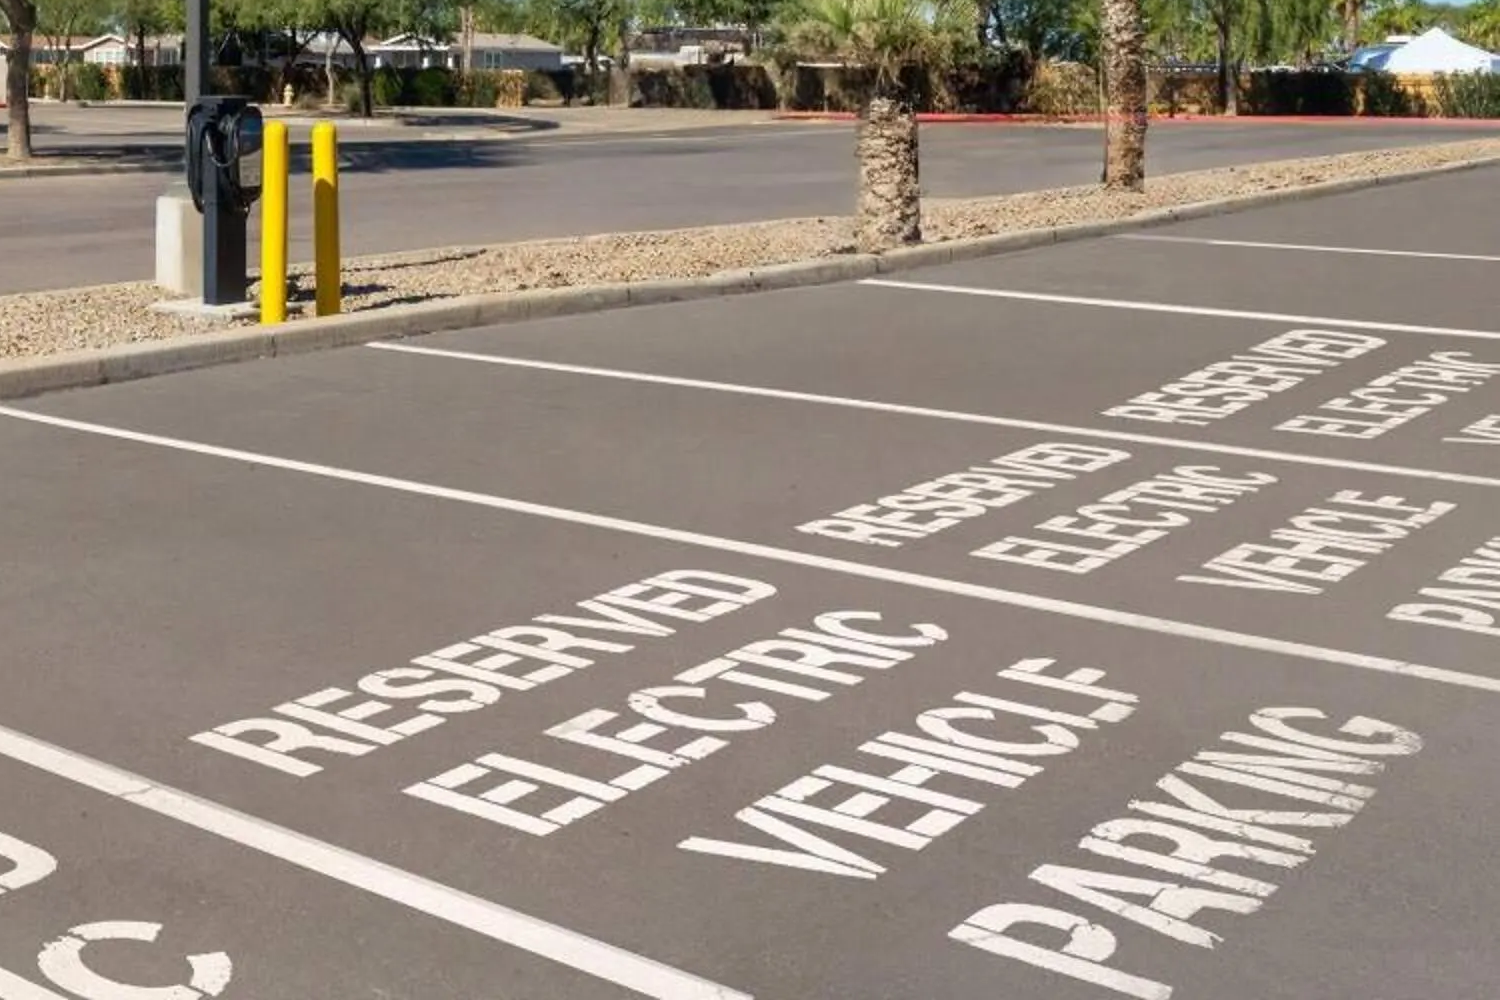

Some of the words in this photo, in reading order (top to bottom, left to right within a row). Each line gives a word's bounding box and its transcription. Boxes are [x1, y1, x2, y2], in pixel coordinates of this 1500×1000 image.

[1102, 329, 1388, 427] RESERVED
[795, 443, 1133, 548] RESERVED
[970, 465, 1279, 574] ELECTRIC
[1175, 489, 1458, 595] VEHICLE
[187, 569, 778, 778] RESERVED
[401, 610, 949, 837] ELECTRIC
[676, 657, 1140, 880] VEHICLE
[947, 706, 1426, 1000] PARKING
